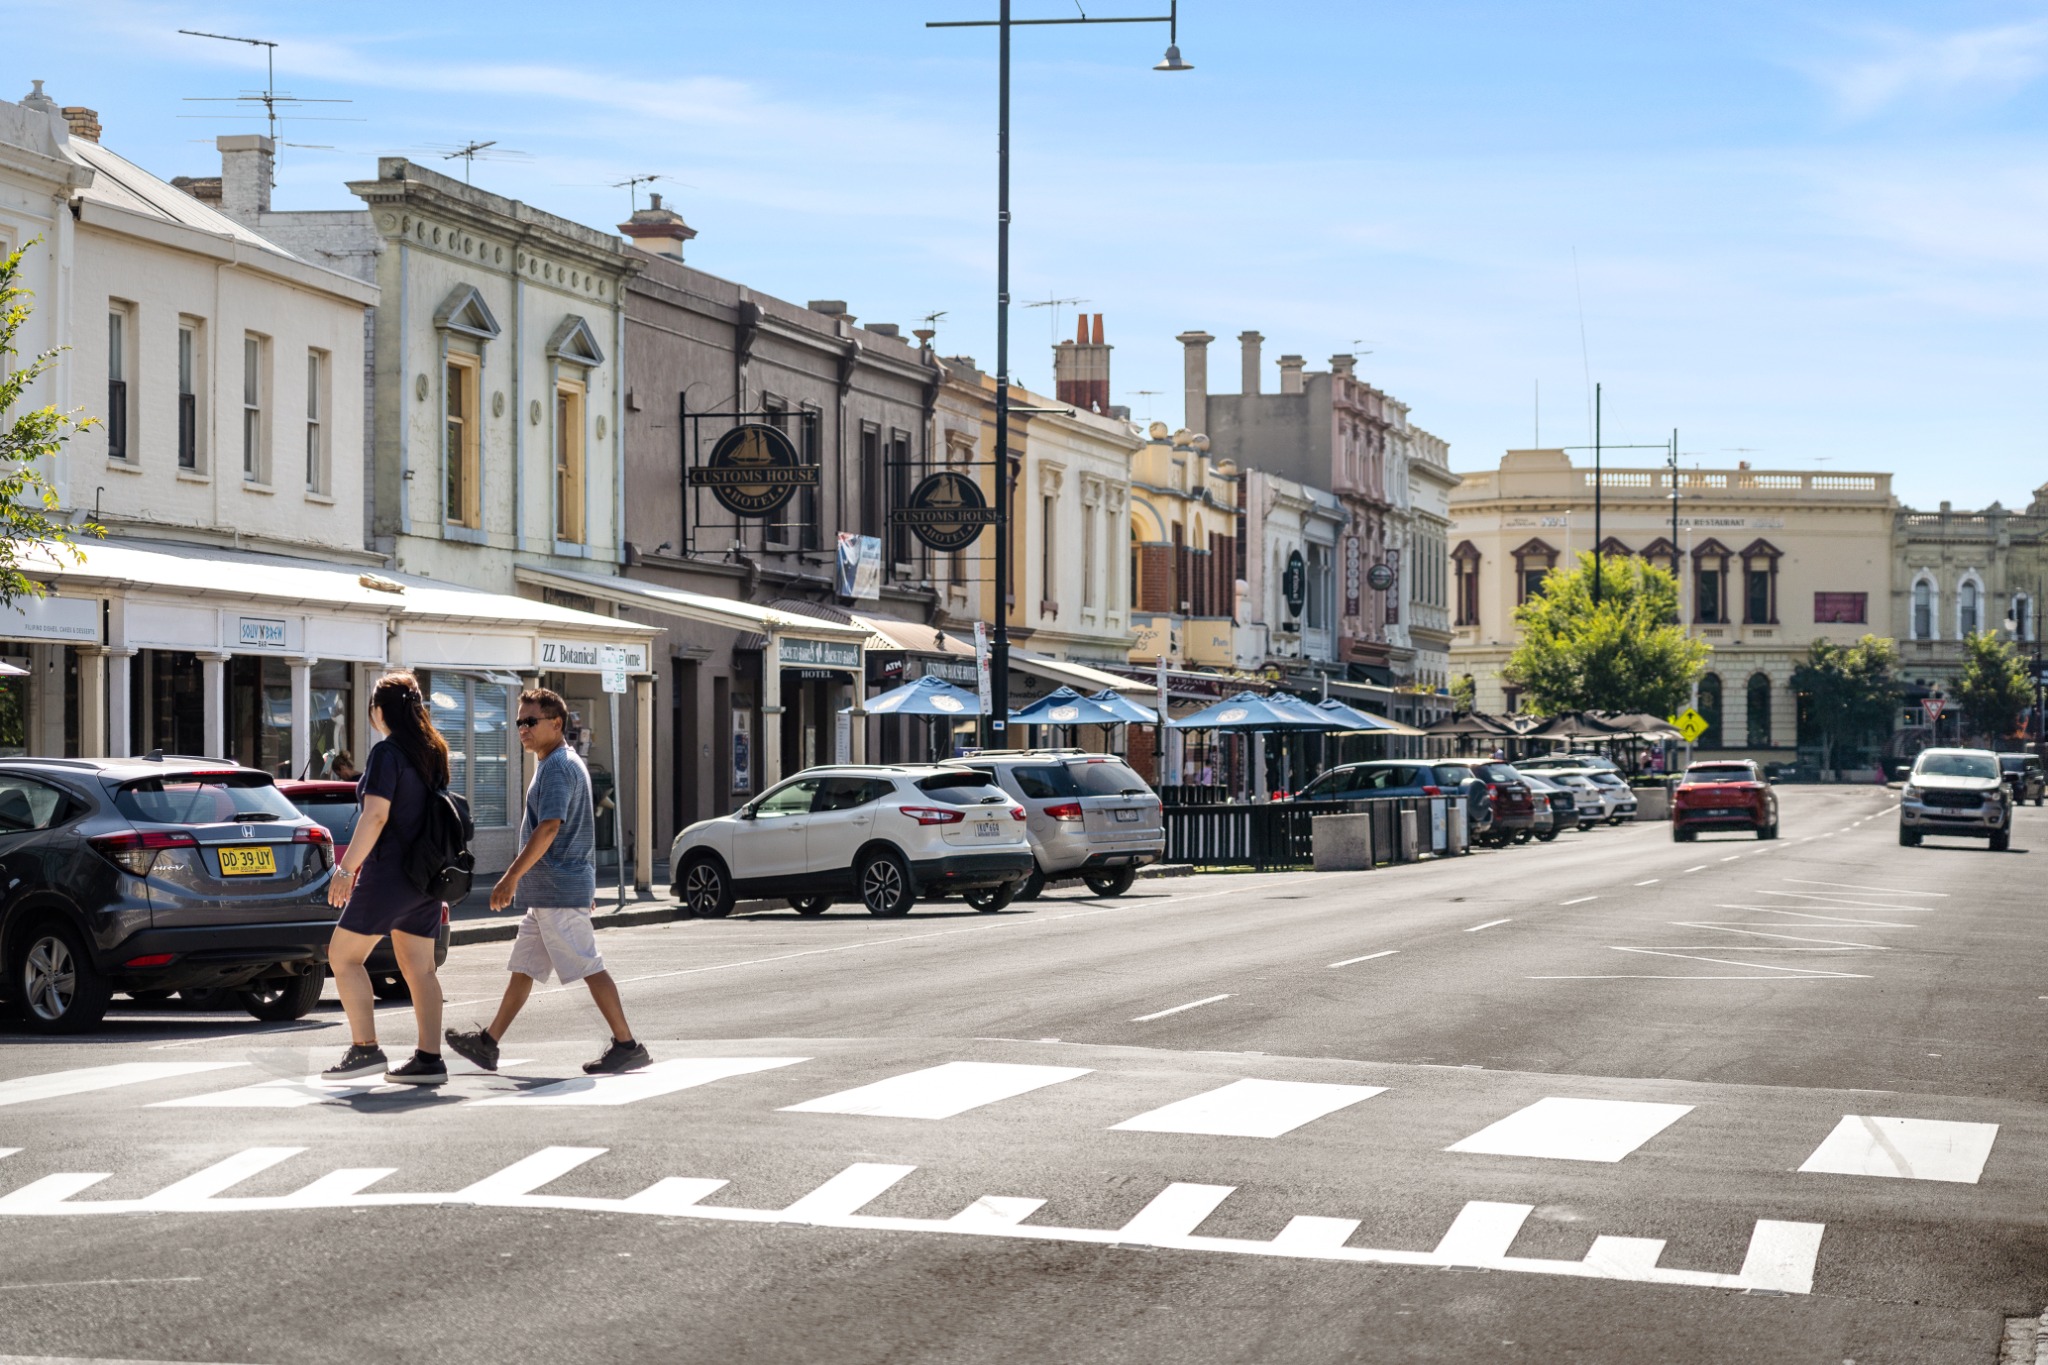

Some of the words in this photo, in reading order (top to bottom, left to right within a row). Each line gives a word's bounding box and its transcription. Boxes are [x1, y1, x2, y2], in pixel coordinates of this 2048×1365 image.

[692, 470, 762, 483] CUSTOMS
[766, 469, 816, 482] HOUSE
[729, 487, 778, 508] HOTEL
[894, 511, 955, 521] CUSTOMS
[926, 529, 969, 543] HOTEL
[543, 643, 556, 662] ZZ
[560, 645, 597, 665] Botanical
[885, 660, 902, 672] ATM
